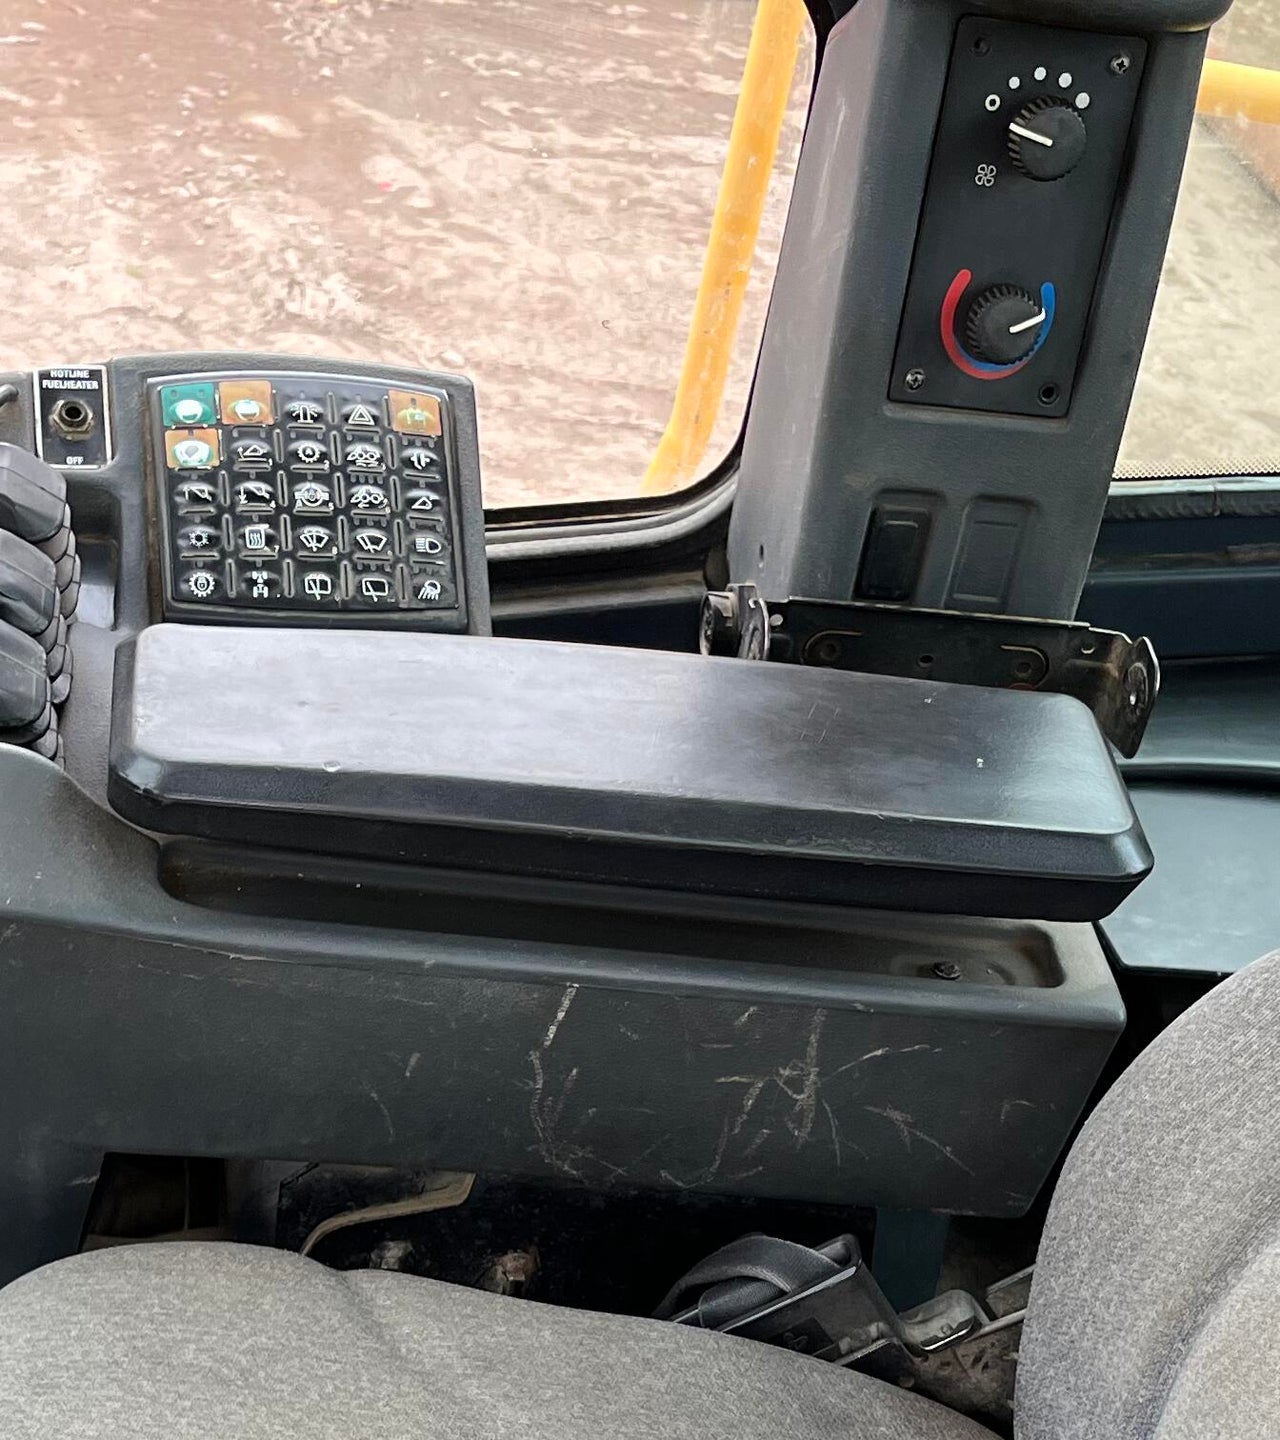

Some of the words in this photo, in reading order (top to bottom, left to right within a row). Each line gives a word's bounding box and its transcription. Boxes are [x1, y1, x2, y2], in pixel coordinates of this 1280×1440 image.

[50, 369, 90, 379] HOTLINE
[42, 379, 99, 390] FUELHEATER
[66, 456, 84, 465] OFF
